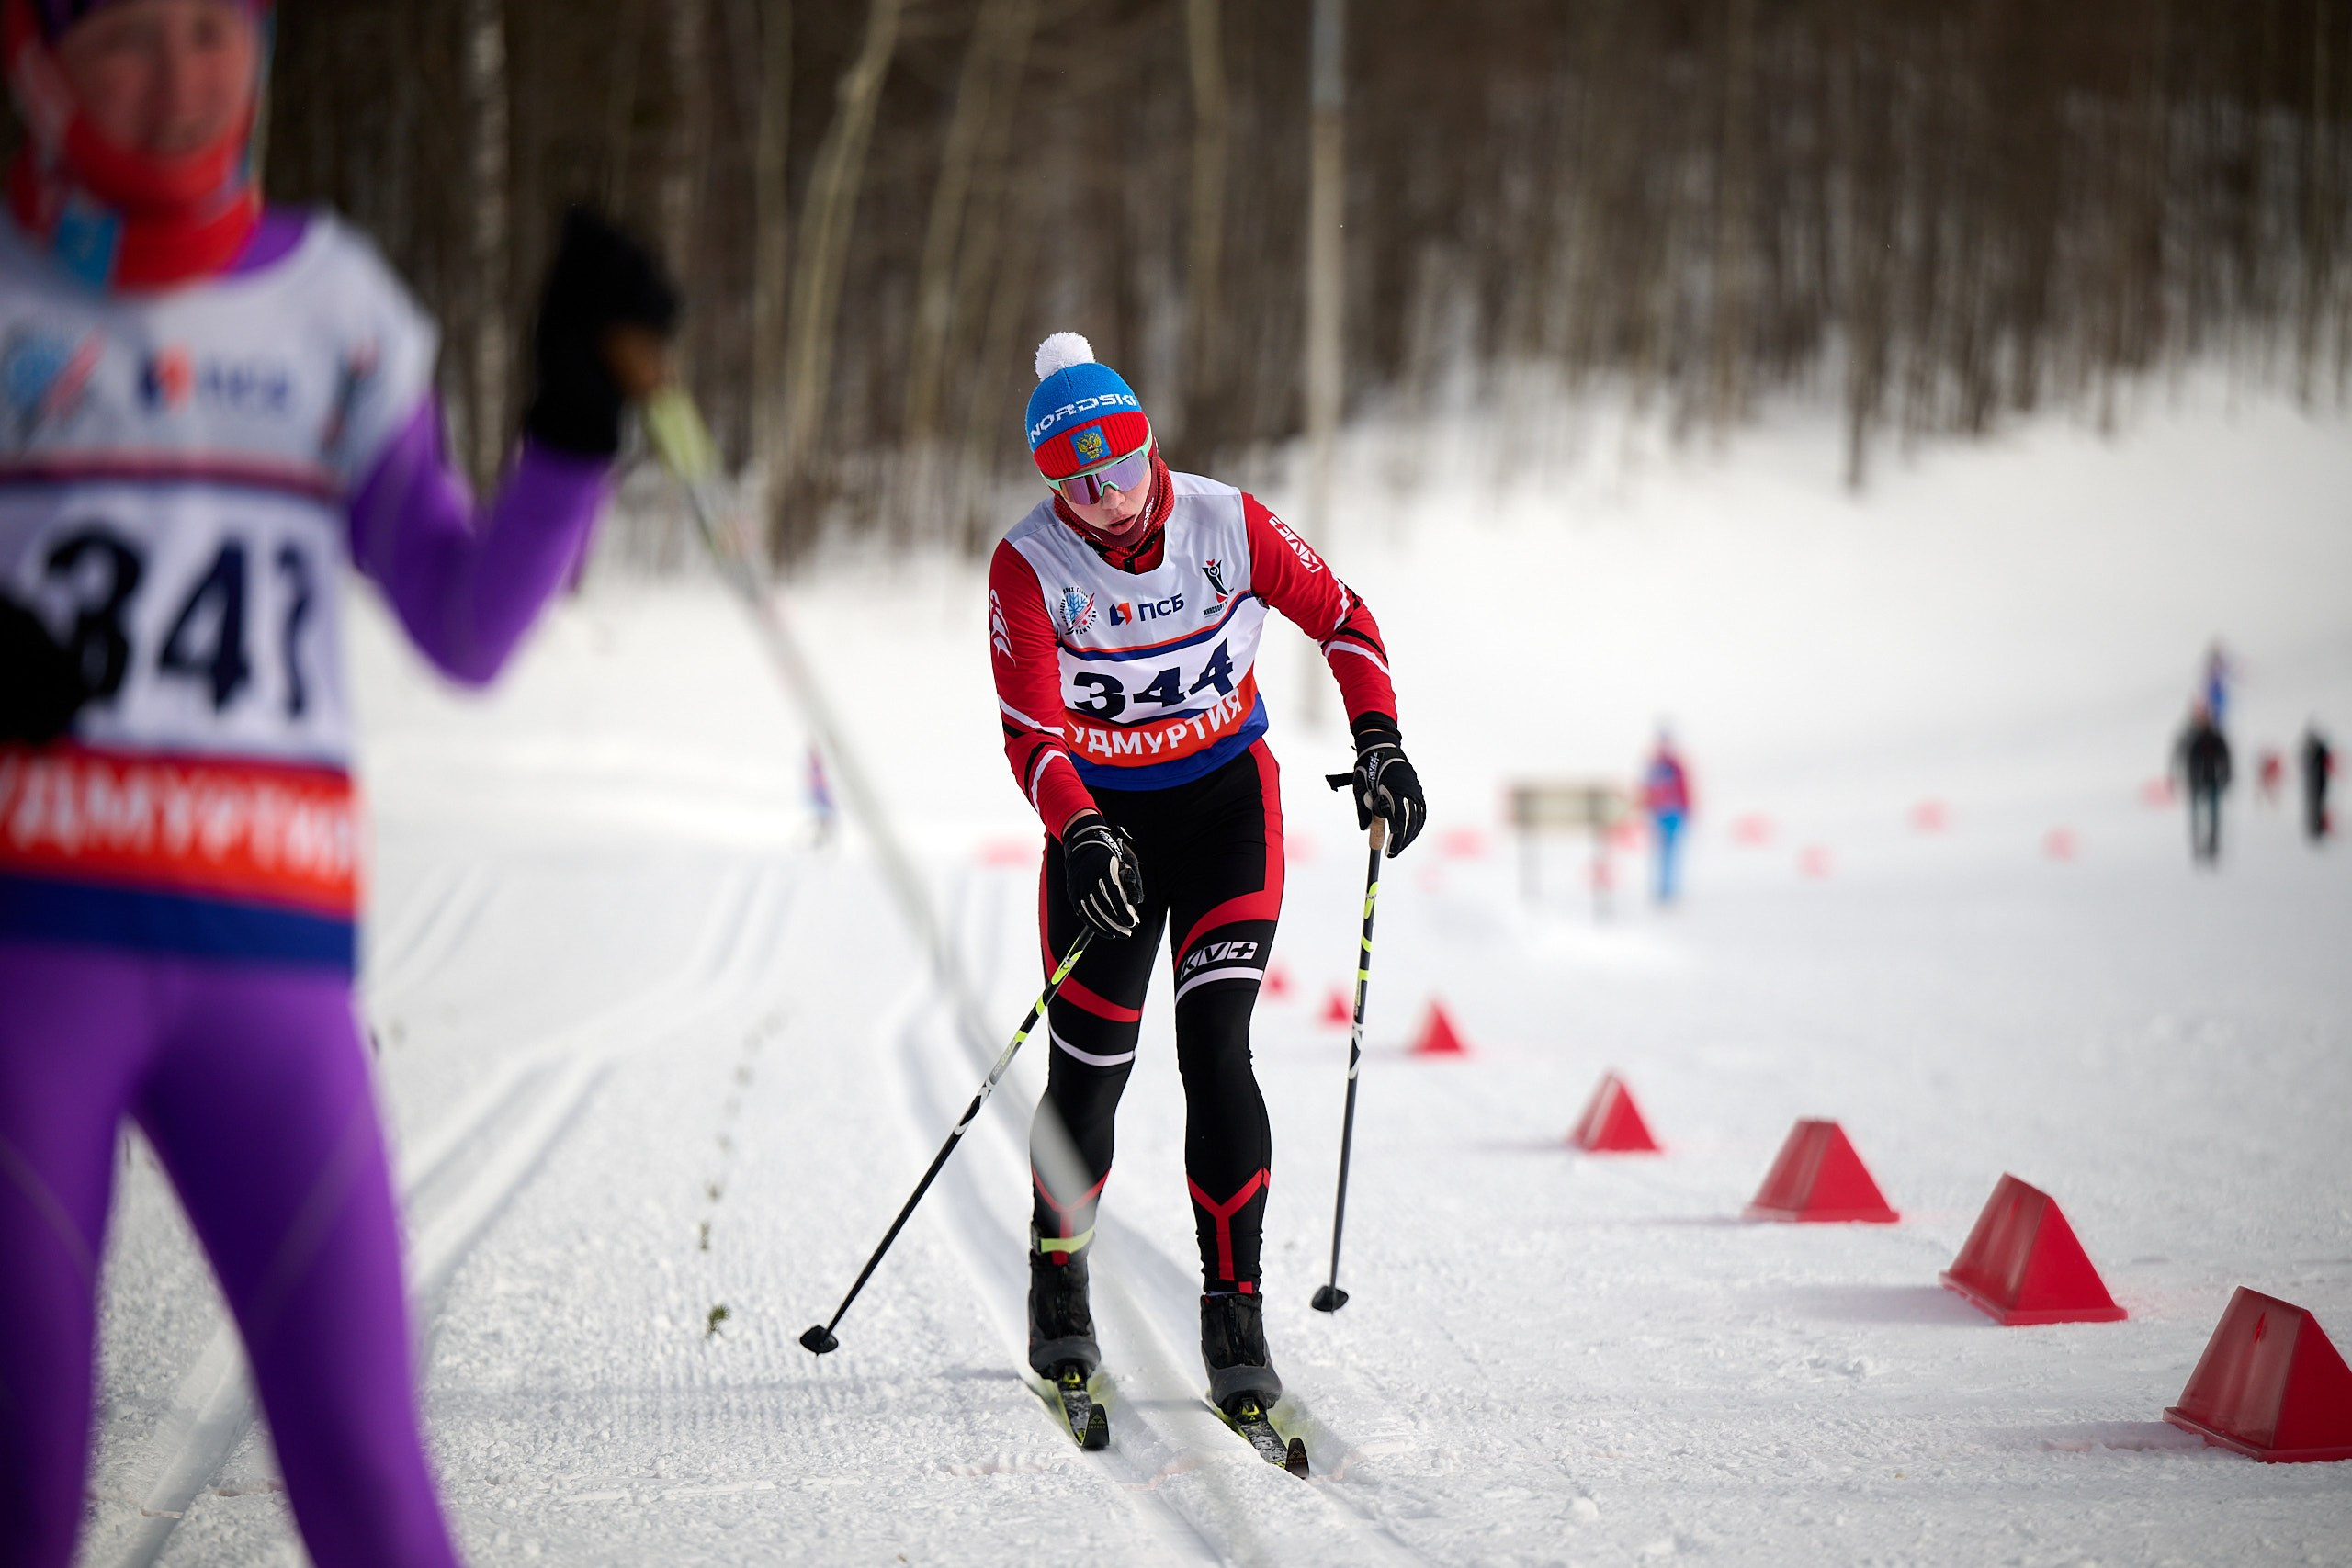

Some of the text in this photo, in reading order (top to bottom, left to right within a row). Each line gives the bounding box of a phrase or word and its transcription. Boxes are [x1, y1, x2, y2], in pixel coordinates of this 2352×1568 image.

[1137, 592, 1185, 622] ПСБ
[1073, 637, 1234, 719] 344
[1066, 688, 1242, 758] УДМУРТИЯ
[1179, 941, 1259, 981] KV+
